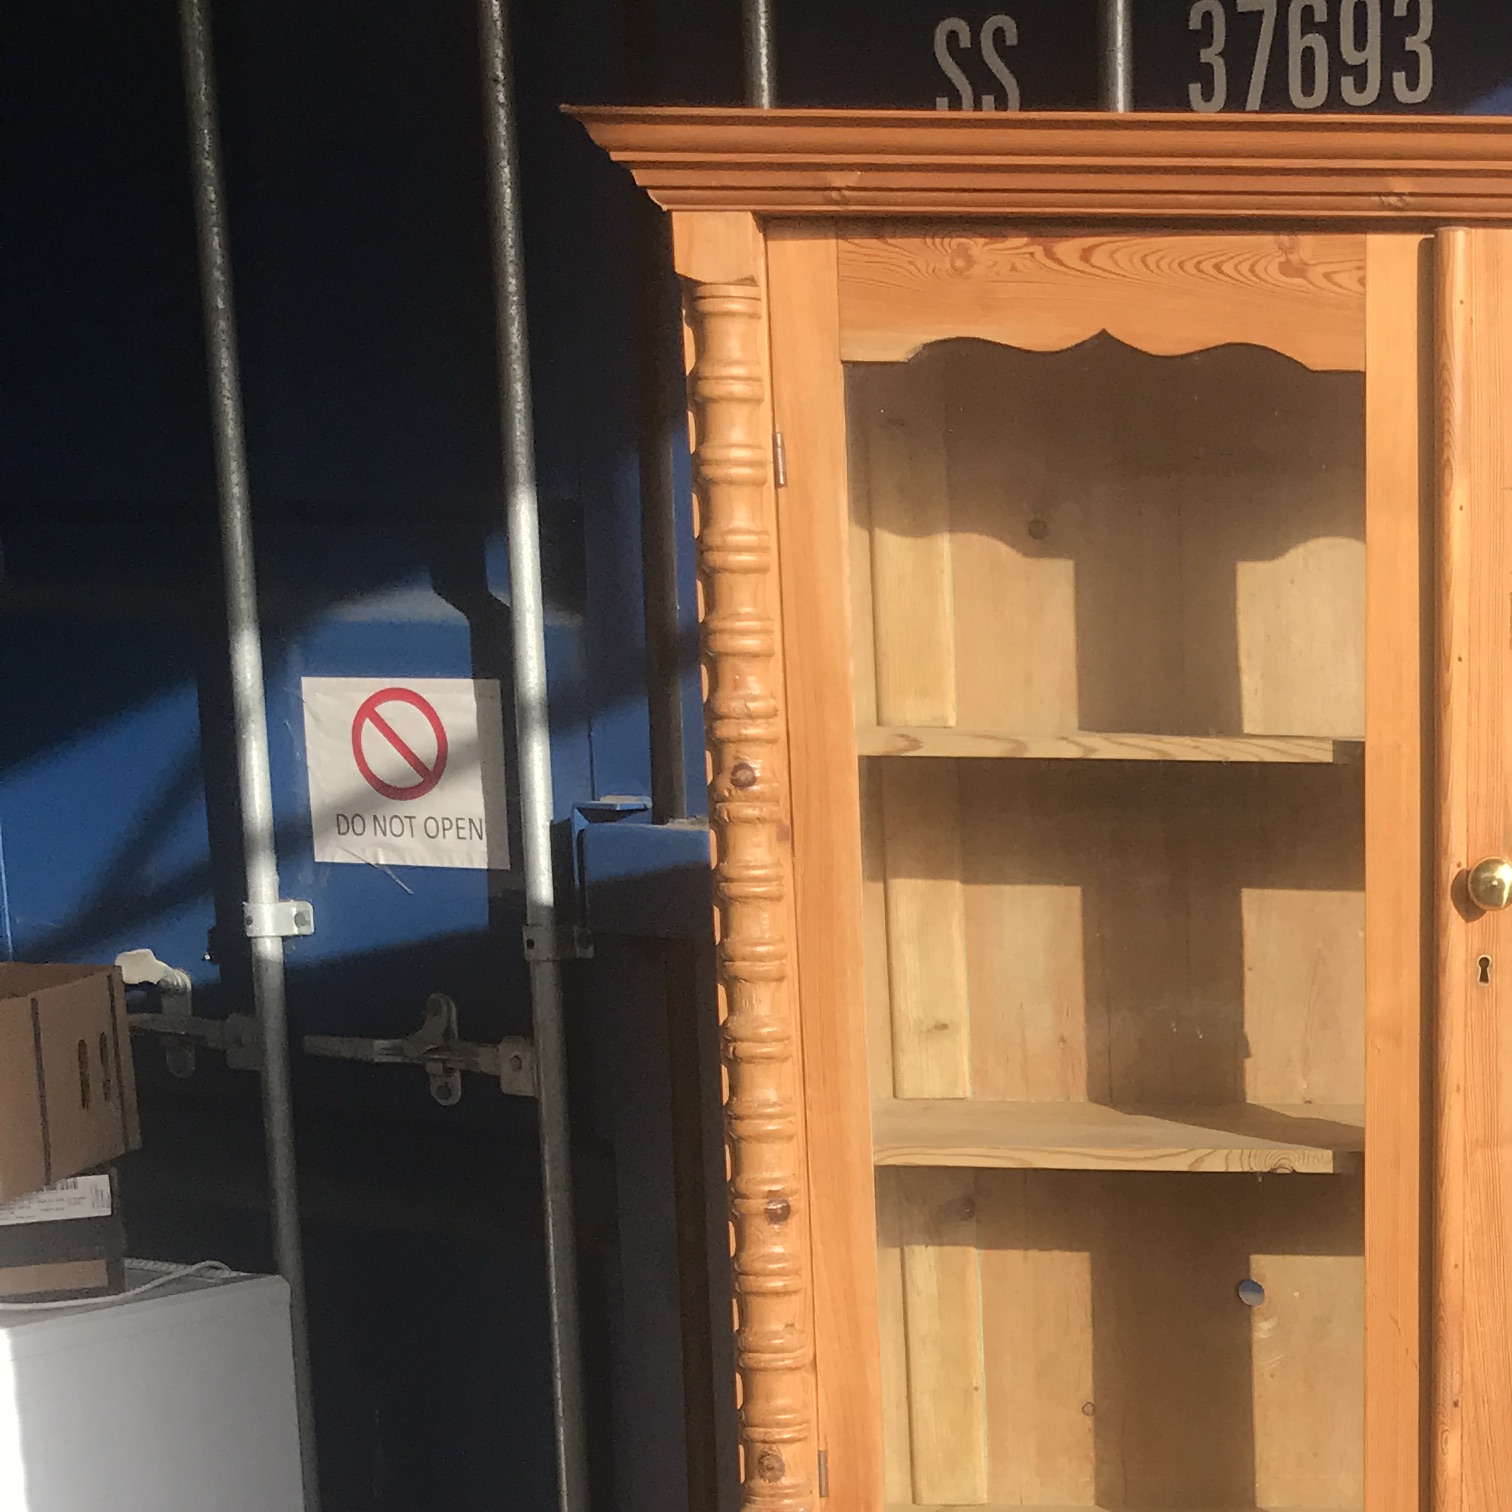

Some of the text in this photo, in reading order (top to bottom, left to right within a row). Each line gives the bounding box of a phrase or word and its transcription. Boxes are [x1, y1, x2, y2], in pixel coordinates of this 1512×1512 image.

[934, 14, 1020, 112] SS
[1187, 0, 1434, 113] 37693
[336, 812, 484, 841] DO NOT OPEN
